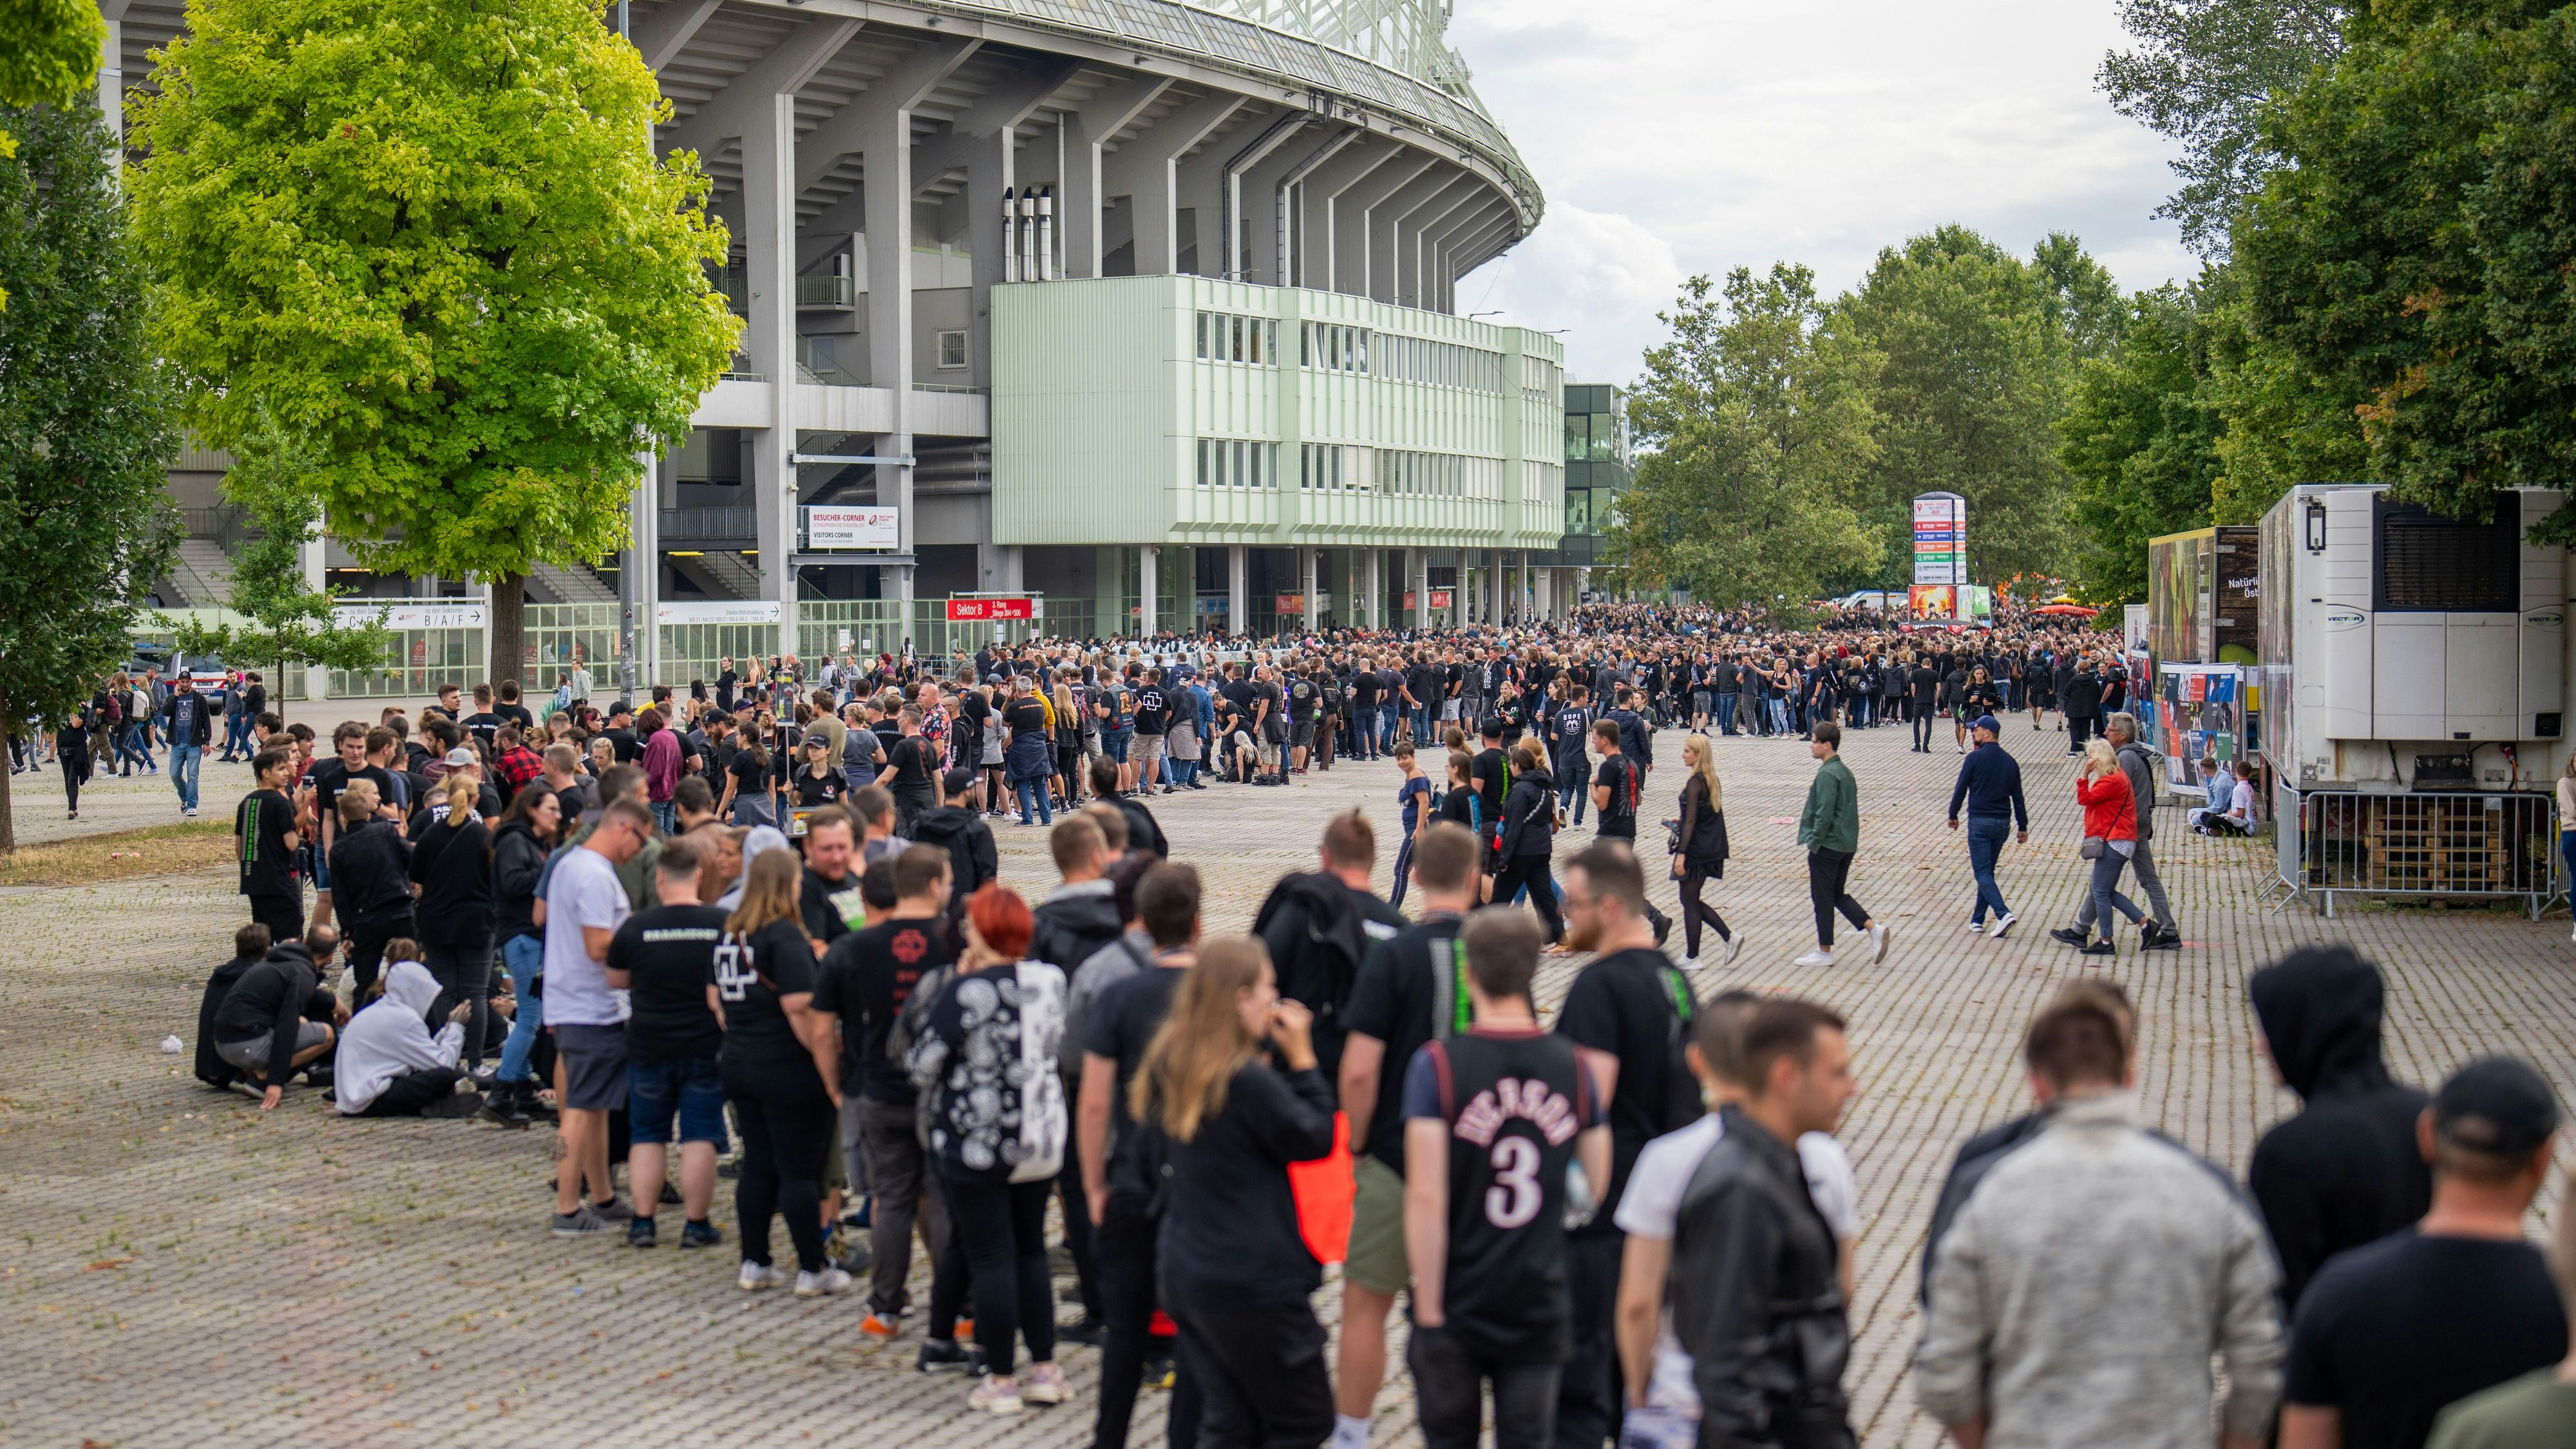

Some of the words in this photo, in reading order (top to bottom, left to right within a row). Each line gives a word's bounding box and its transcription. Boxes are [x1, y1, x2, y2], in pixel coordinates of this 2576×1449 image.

[957, 604, 976, 615] Sektor
[978, 604, 982, 615] B
[997, 601, 1007, 609] Rang
[1281, 600, 1291, 609] Sektor
[992, 609, 1003, 618] Stiege
[350, 616, 355, 627] C
[424, 615, 430, 626] B
[441, 615, 448, 626] A
[458, 614, 462, 625] F
[1484, 1135, 1543, 1229] 3
